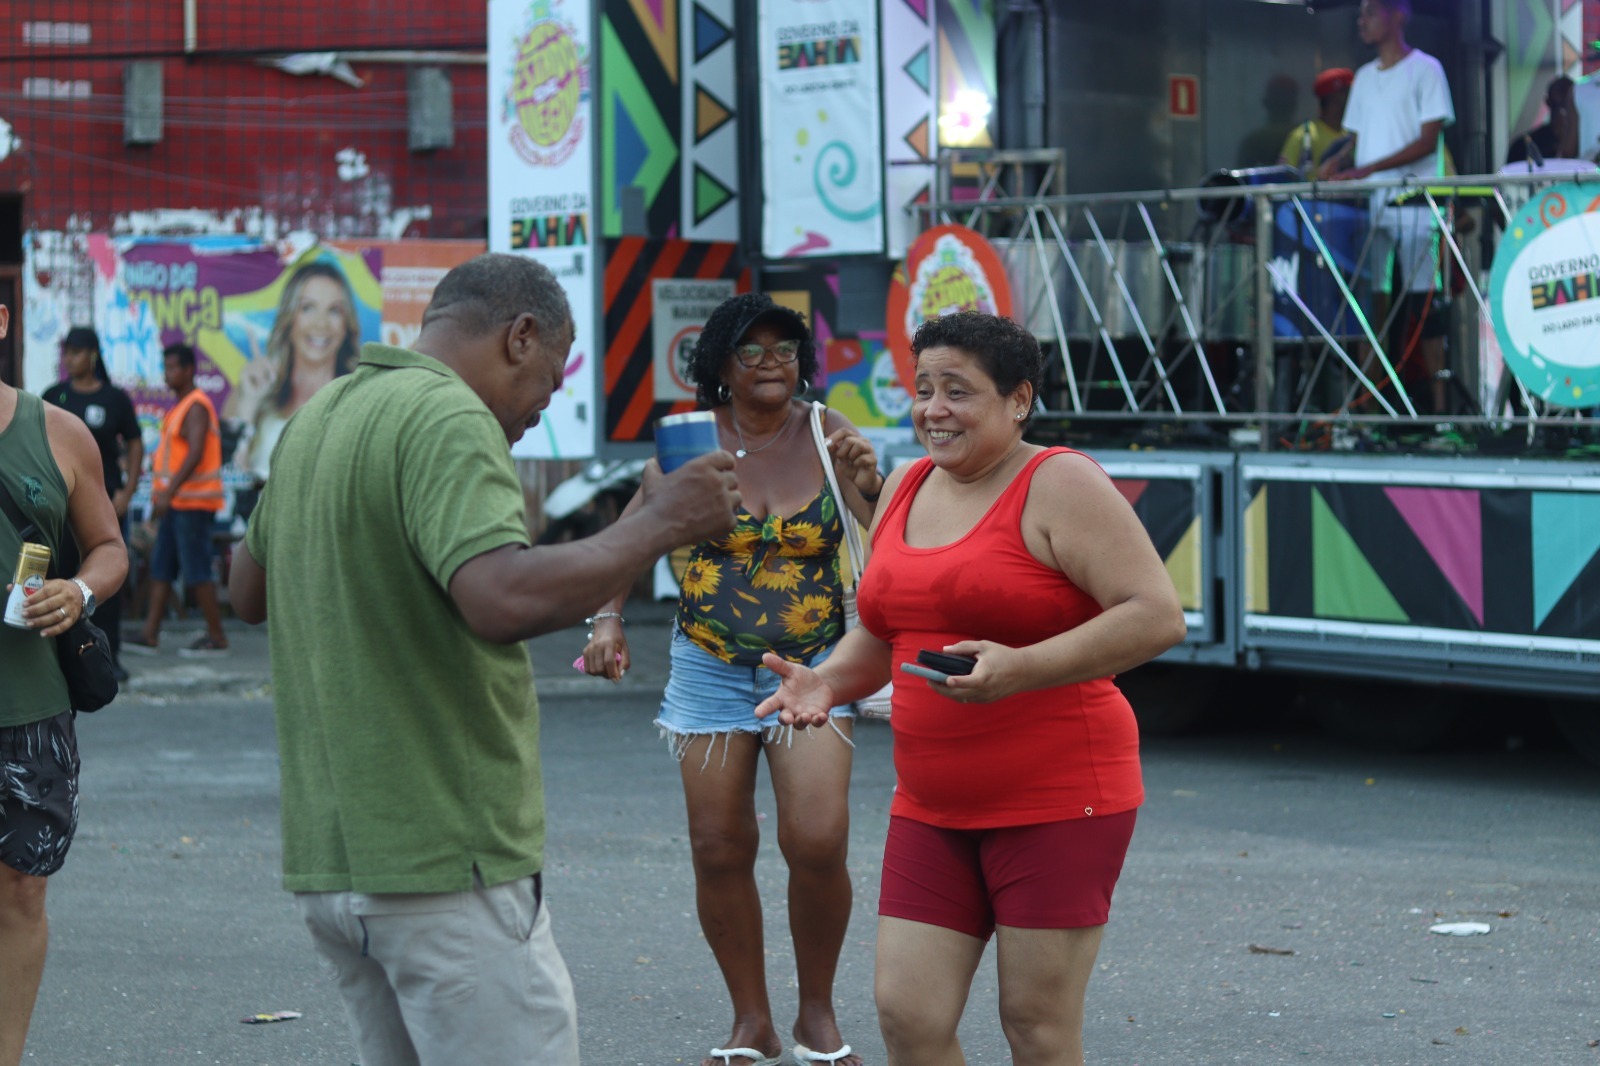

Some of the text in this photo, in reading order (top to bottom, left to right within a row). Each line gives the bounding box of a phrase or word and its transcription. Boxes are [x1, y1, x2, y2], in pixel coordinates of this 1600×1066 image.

[779, 37, 860, 70] BAHIA
[511, 213, 587, 249] BAHIA
[1529, 254, 1599, 280] GOVERNO
[1532, 271, 1600, 310] BAHI
